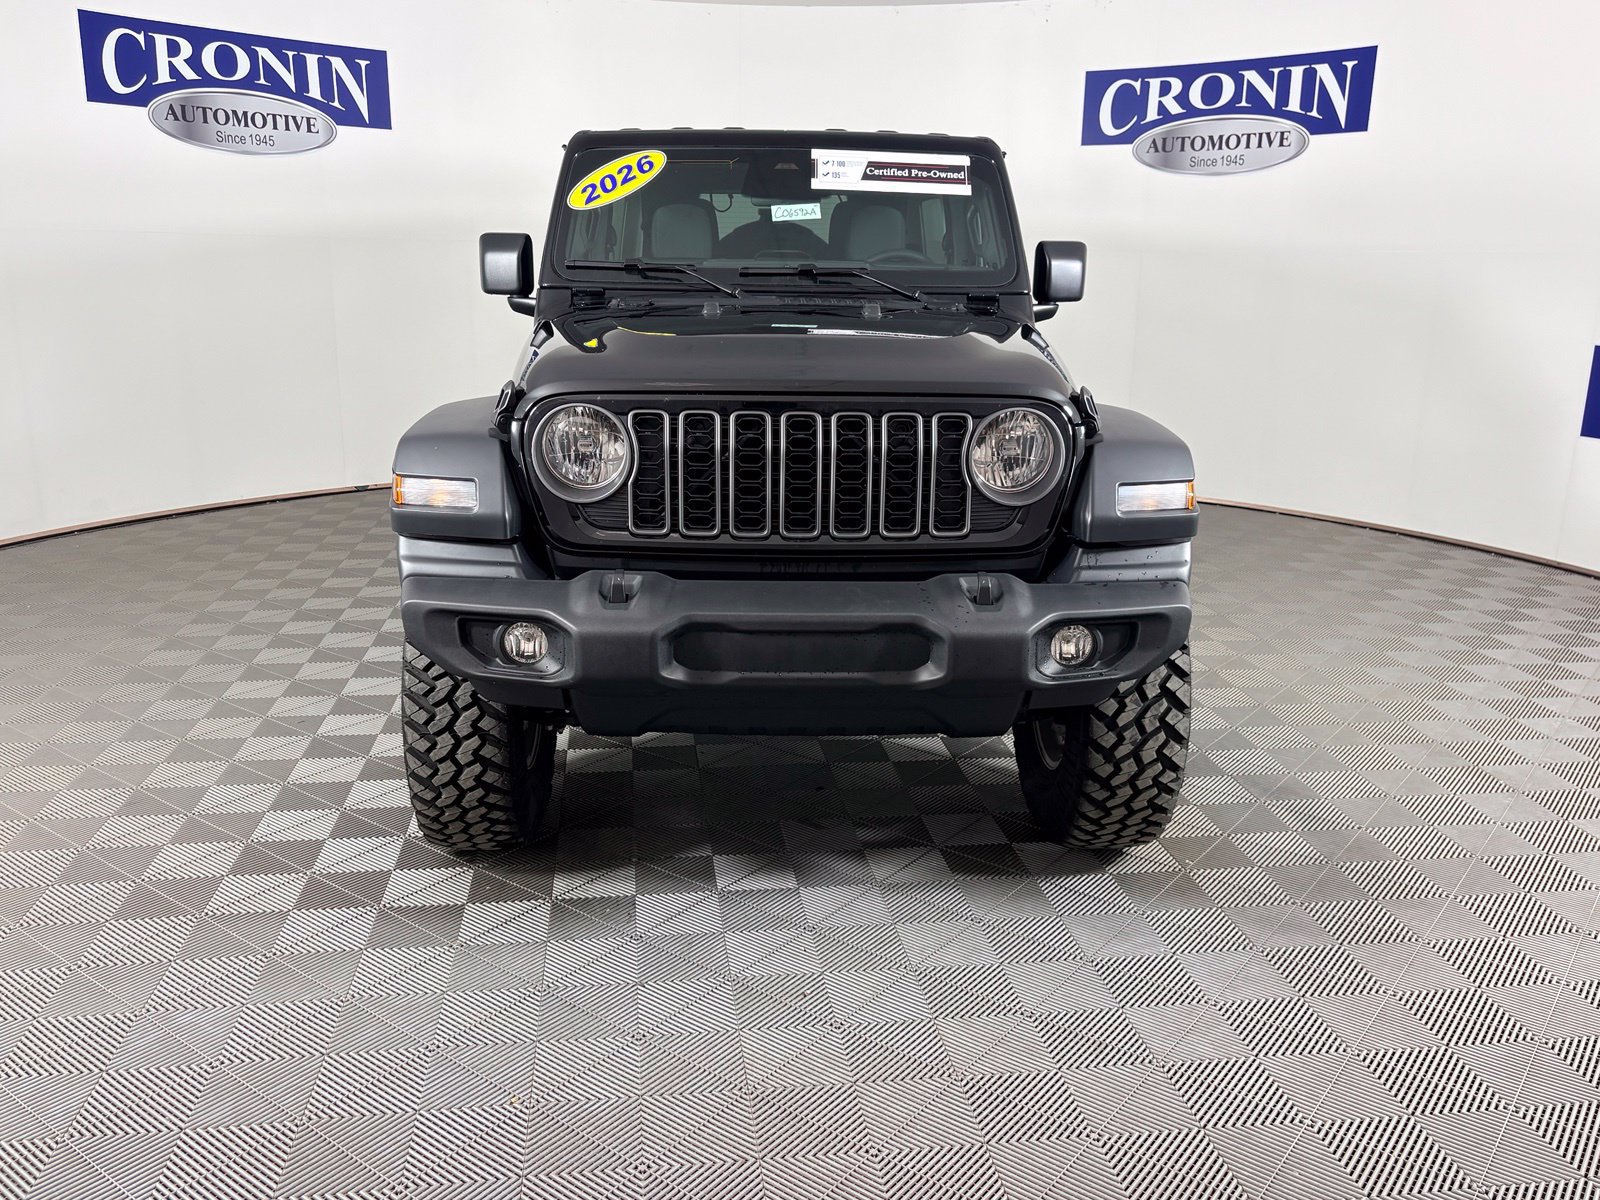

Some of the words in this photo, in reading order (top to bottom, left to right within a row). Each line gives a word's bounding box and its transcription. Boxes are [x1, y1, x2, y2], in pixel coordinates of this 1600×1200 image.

[101, 27, 371, 125] CRONIN
[1099, 60, 1359, 136] CRONIN
[163, 102, 320, 134] AUTOMOTIVE
[215, 130, 247, 146] Since
[248, 133, 276, 147] 1945
[1146, 129, 1292, 154] AUTOMOTIVE
[865, 166, 909, 177] Certified
[911, 168, 965, 180] Pre-Owned
[1188, 155, 1218, 168] Since
[1219, 154, 1246, 168] 1945
[580, 154, 655, 206] 2026
